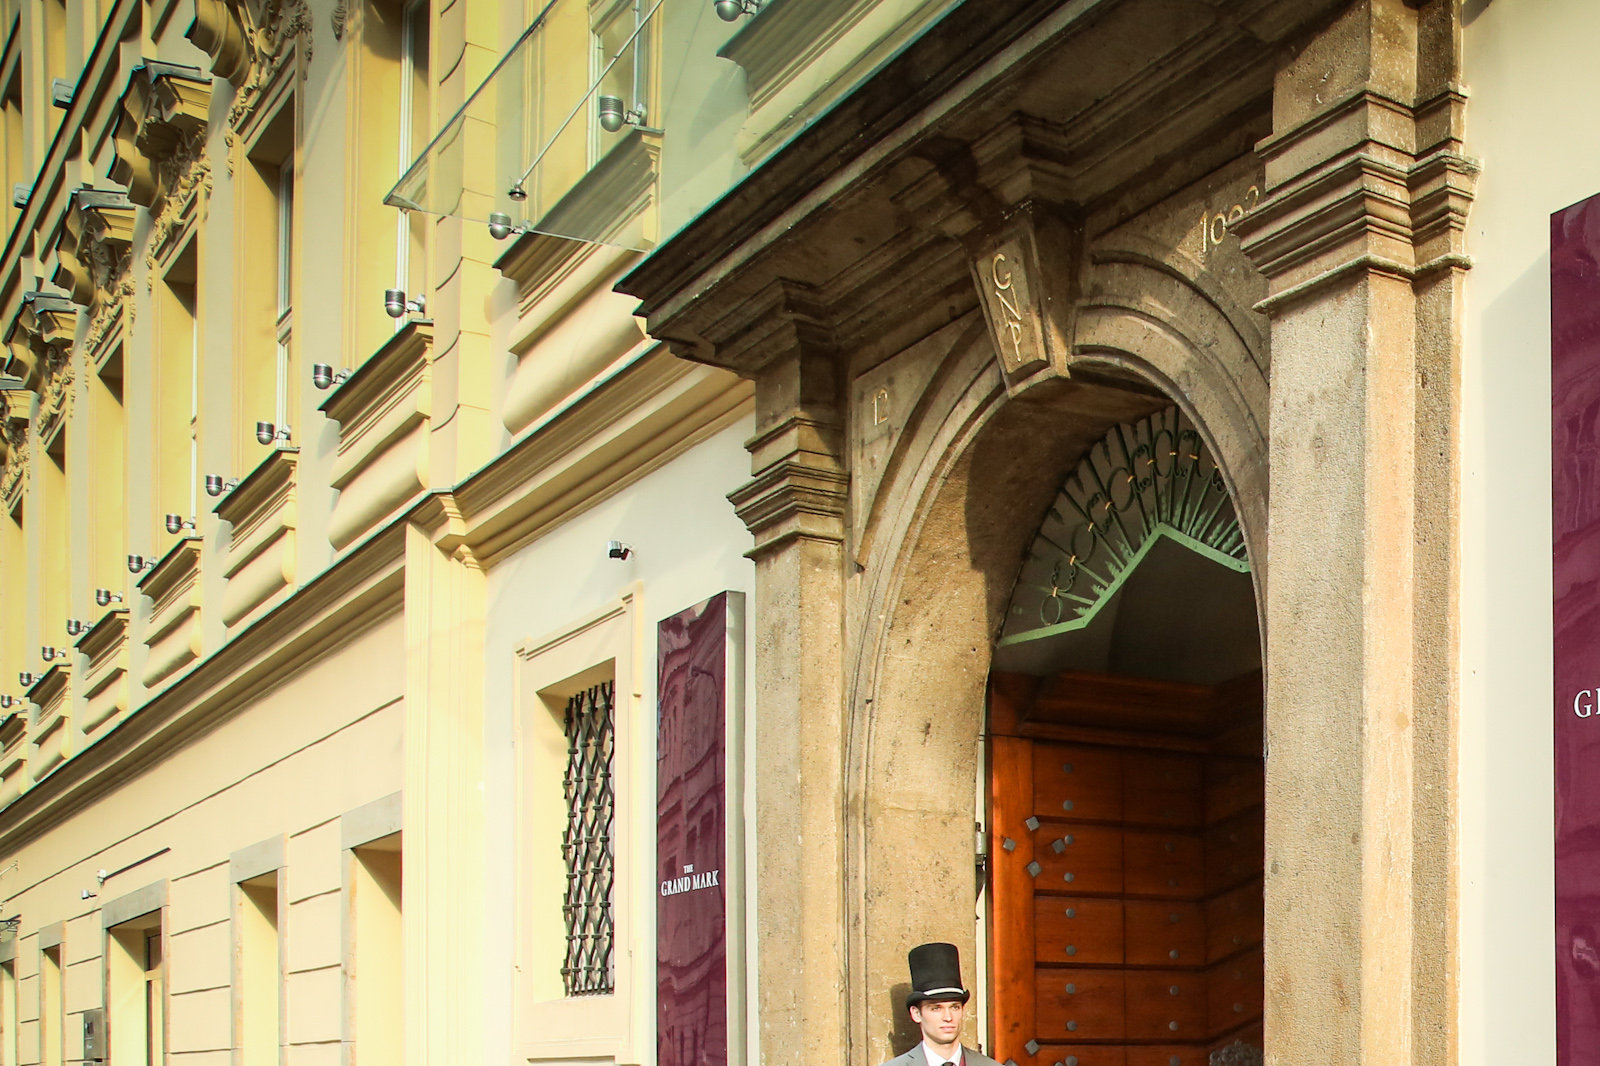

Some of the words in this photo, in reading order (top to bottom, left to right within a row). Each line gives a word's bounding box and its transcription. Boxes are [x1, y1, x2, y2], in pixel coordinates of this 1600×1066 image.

[871, 388, 889, 426] 12
[683, 864, 694, 874] THE
[661, 876, 691, 897] GRAND
[692, 870, 719, 890] MARK
